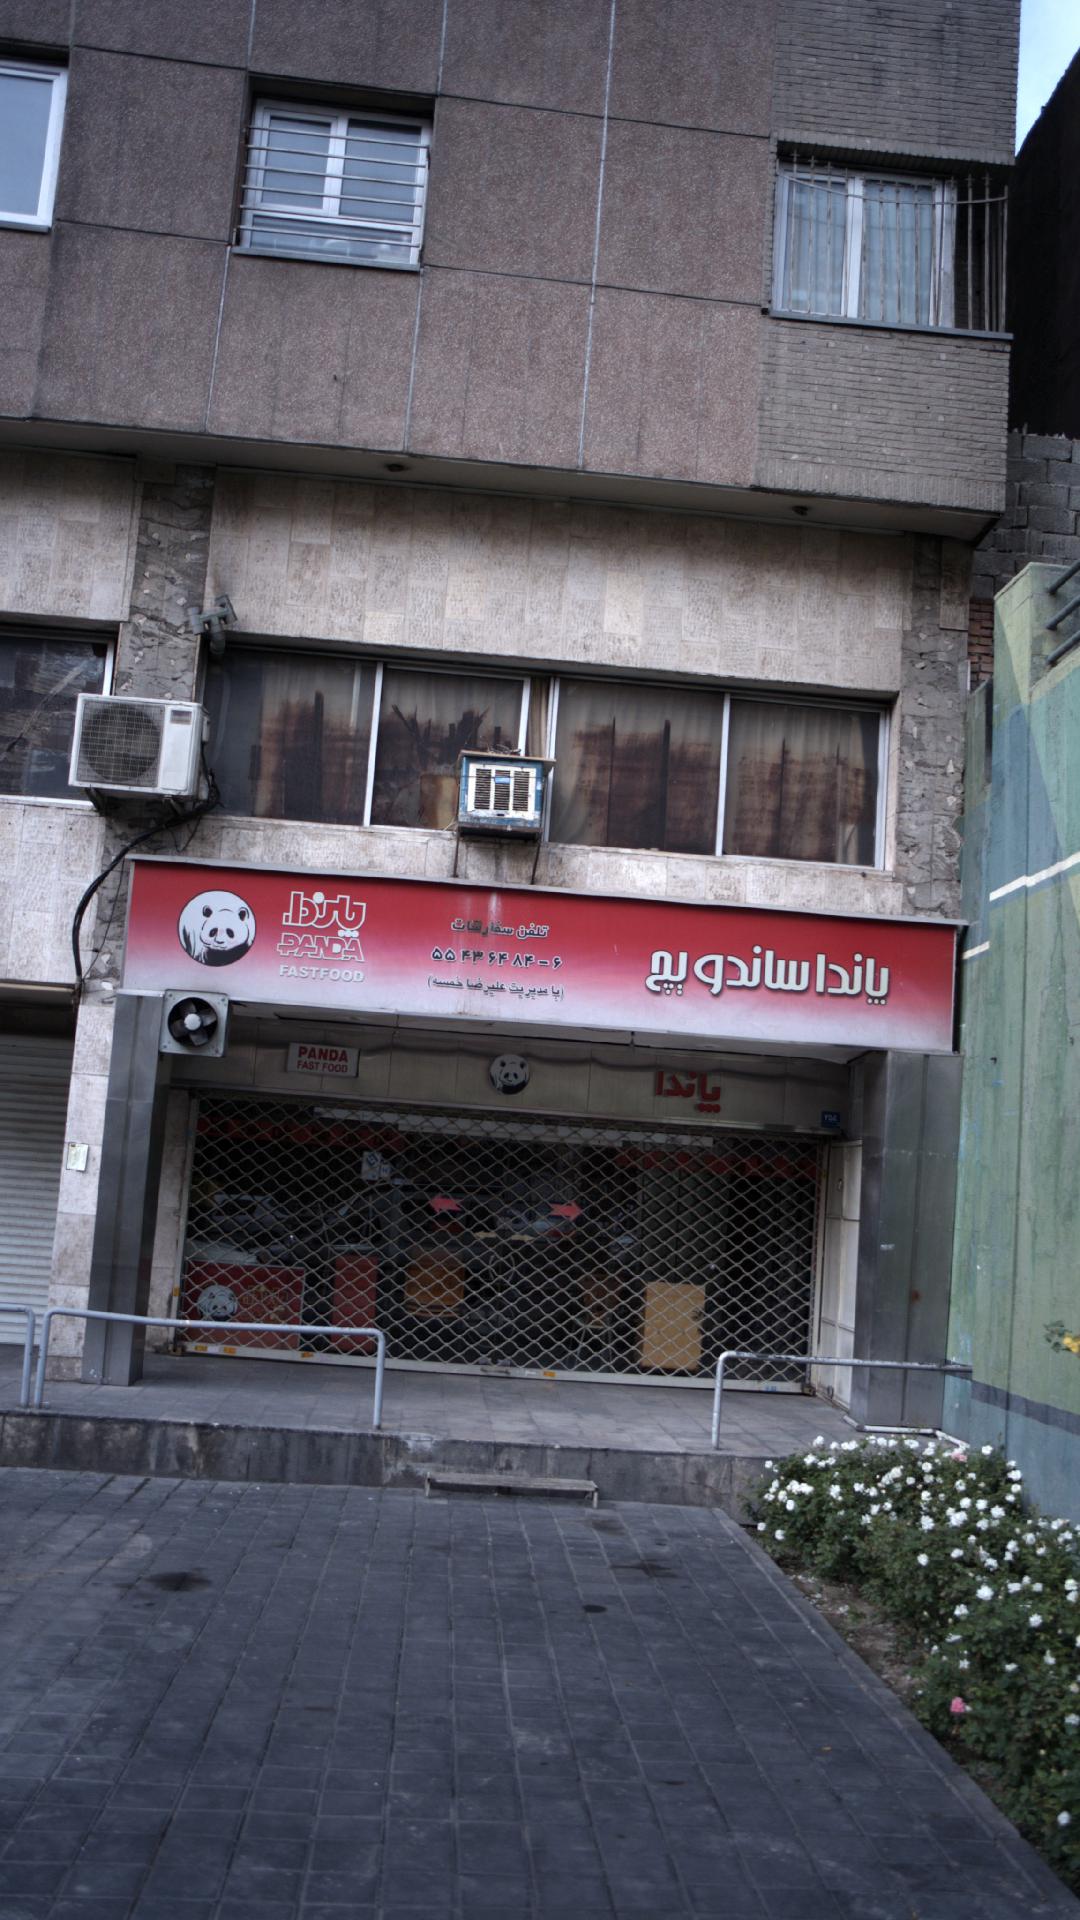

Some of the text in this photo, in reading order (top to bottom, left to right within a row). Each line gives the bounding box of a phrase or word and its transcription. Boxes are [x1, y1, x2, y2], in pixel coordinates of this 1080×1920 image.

[282, 891, 366, 938] پاندا
[516, 923, 549, 939] تلفن
[277, 932, 365, 962] PANDA
[279, 965, 365, 982] FASTFOOD
[645, 944, 890, 1005] پاندا ساندویچ
[297, 1046, 348, 1063] PANDA
[297, 1060, 348, 1073] FAST FOOD
[655, 1070, 721, 1113] پاندا
